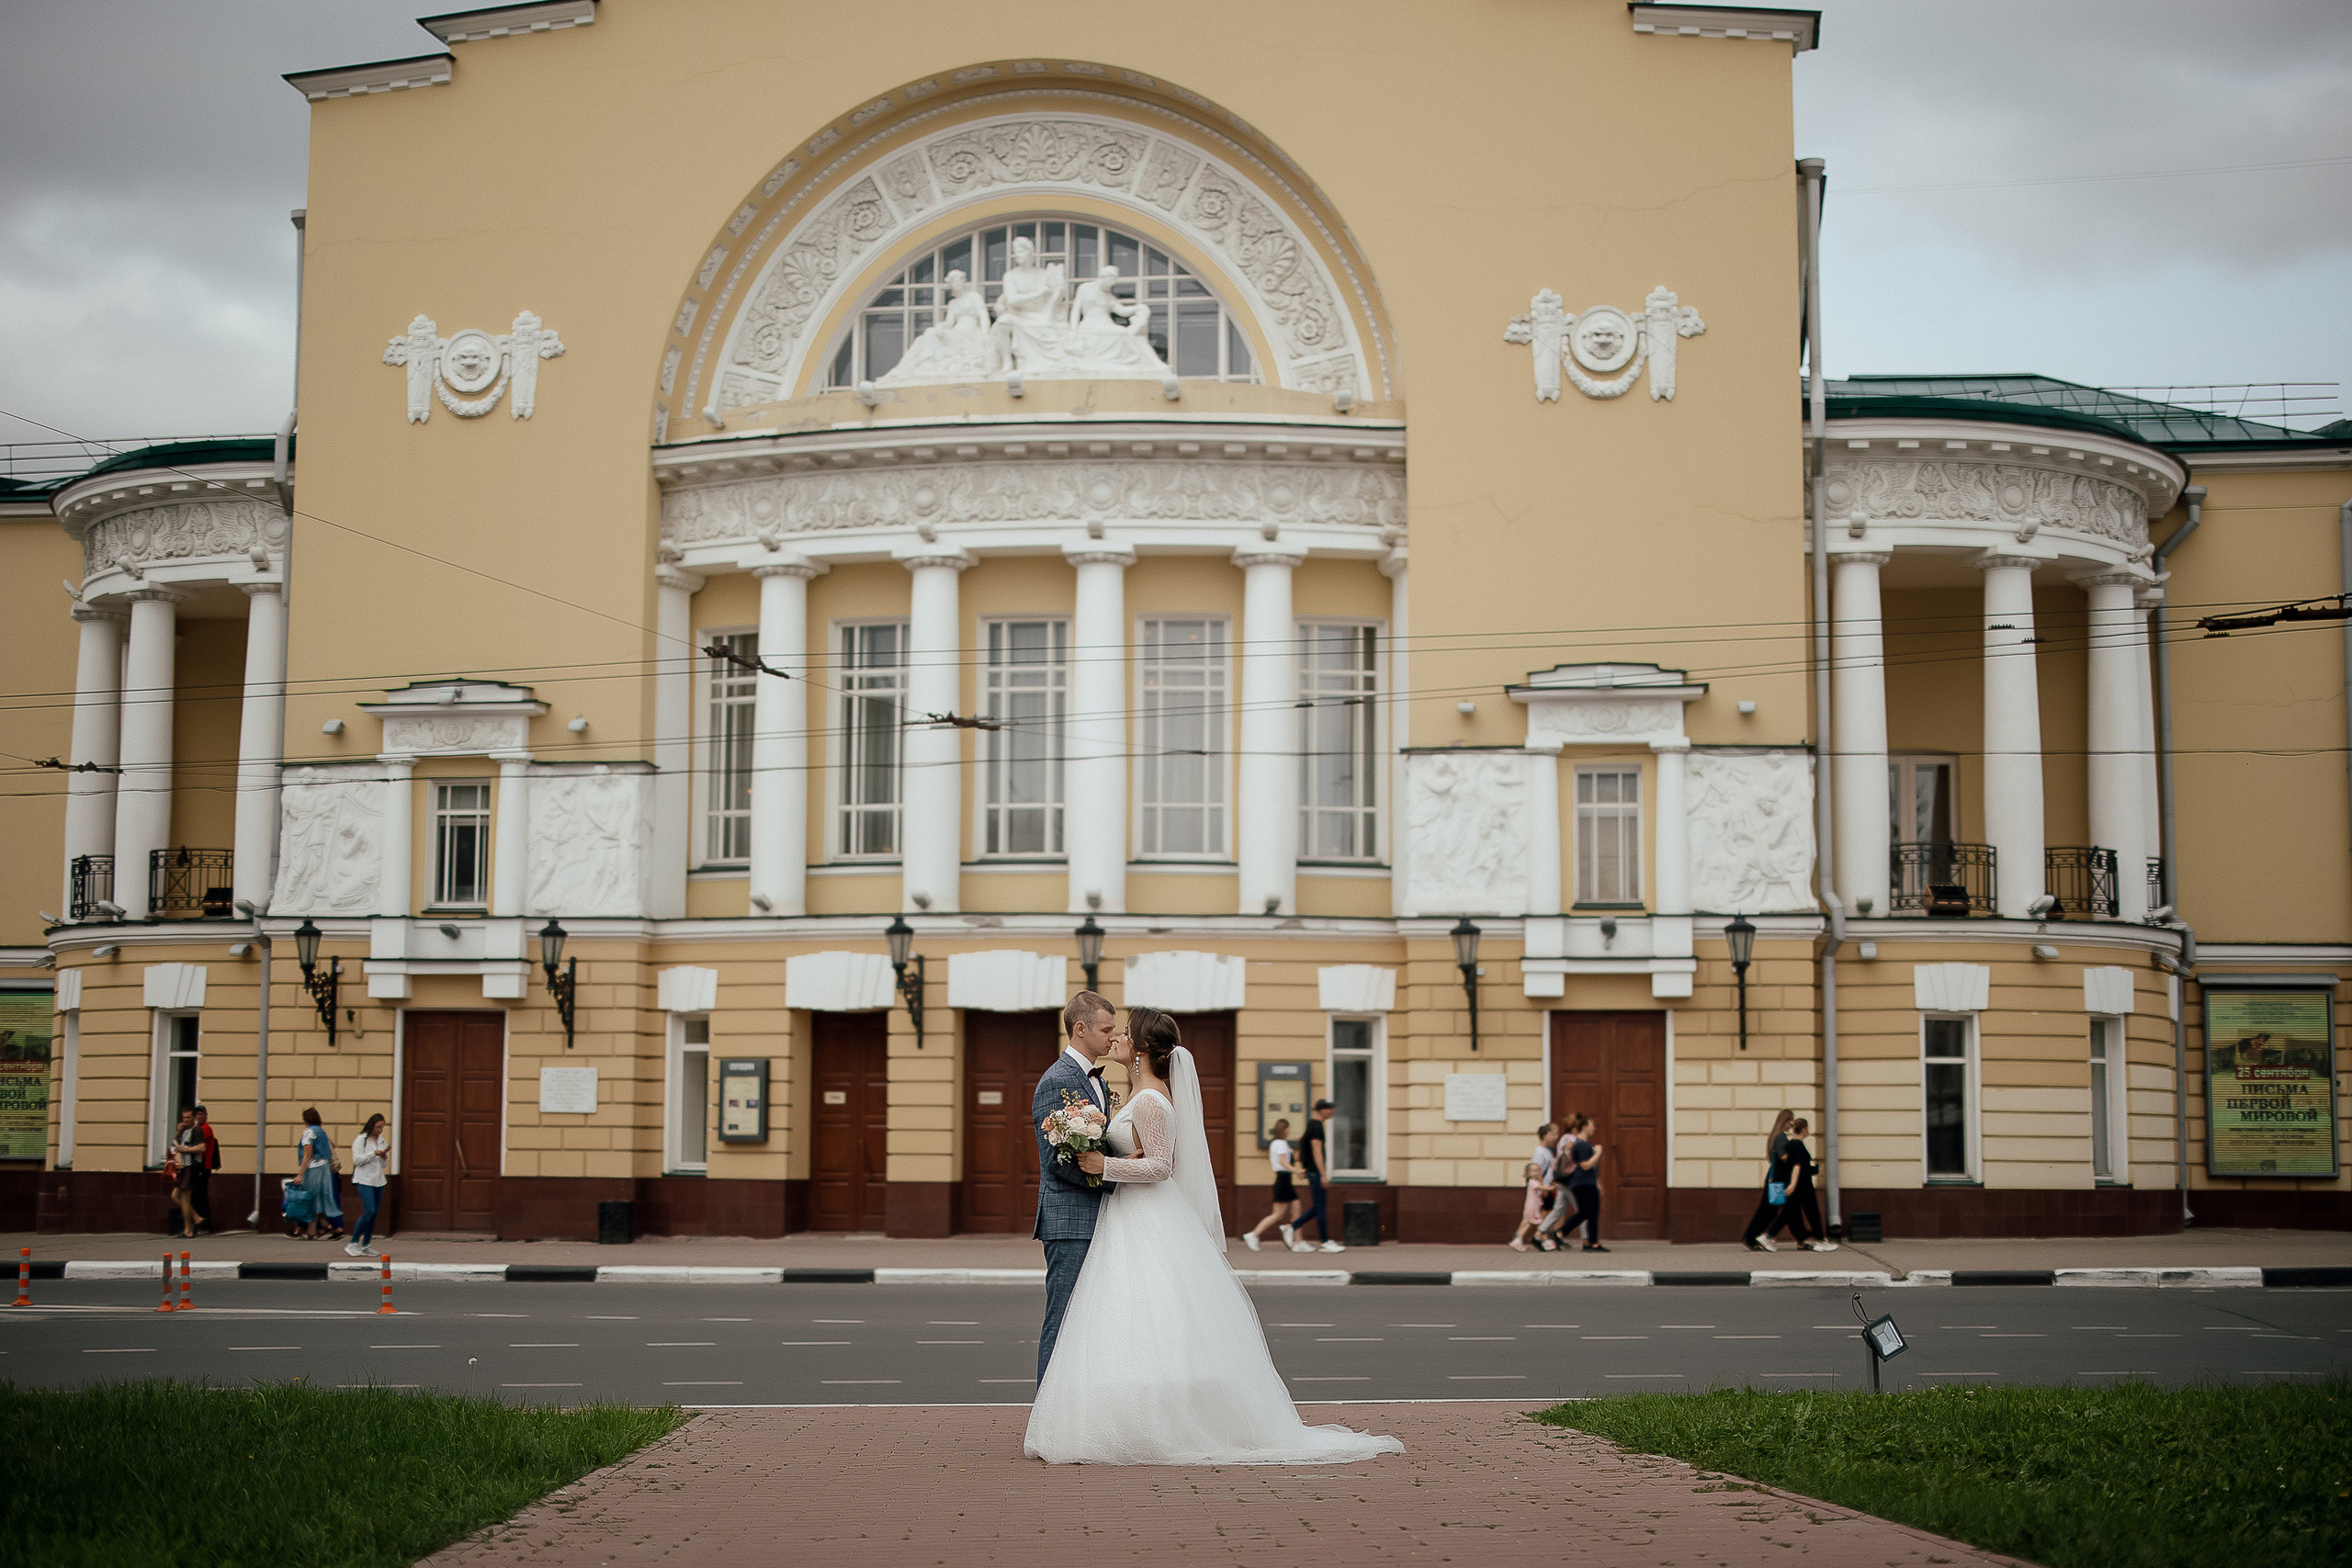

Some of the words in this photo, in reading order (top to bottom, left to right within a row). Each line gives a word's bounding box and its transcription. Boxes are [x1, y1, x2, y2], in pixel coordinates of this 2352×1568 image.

[2237, 1066, 2251, 1078] 25
[2254, 1066, 2309, 1079] сентября
[0, 1077, 41, 1086] ИСЬМА
[0, 1086, 26, 1099] ВОЙ
[2241, 1084, 2309, 1095] ПИСЬМА
[2227, 1096, 2291, 1109] ПЕРВОЙ
[2240, 1109, 2318, 1122] МИРОВОЙ
